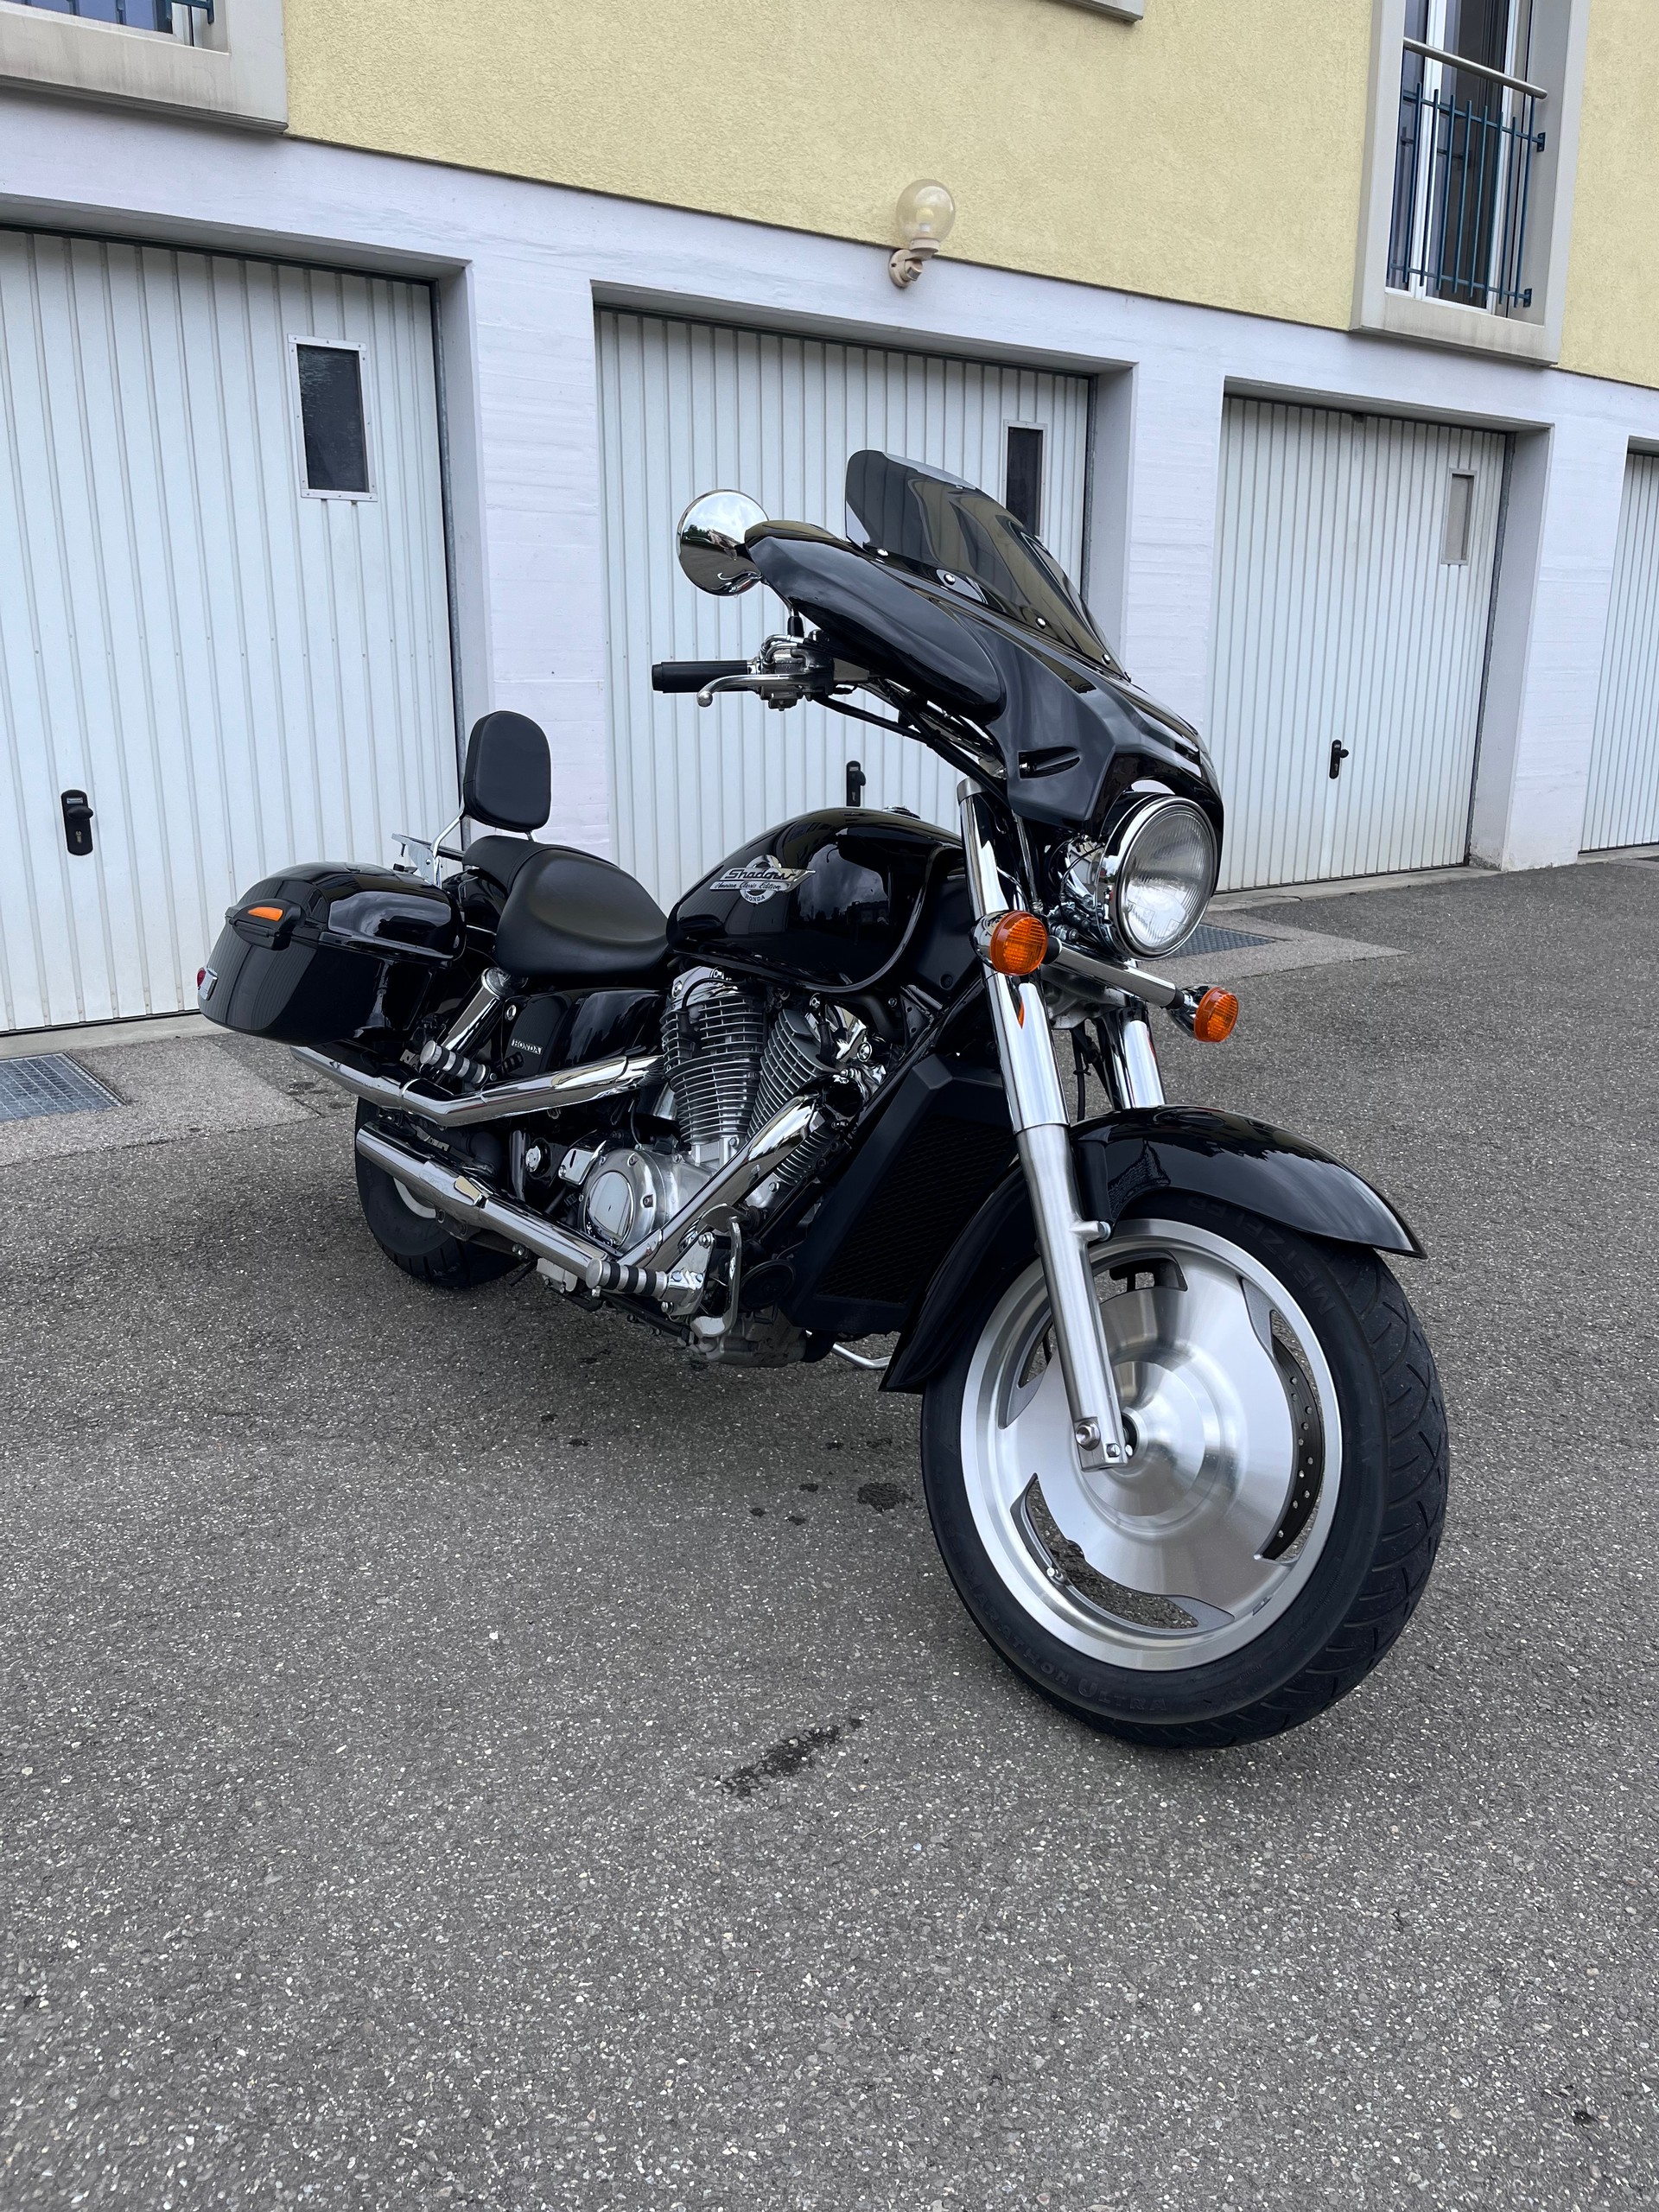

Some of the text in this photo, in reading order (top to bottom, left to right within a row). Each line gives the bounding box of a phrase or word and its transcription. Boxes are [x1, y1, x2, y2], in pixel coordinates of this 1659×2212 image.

[724, 868, 796, 880] Shadow
[745, 893, 766, 902] HONDA
[512, 1039, 543, 1054] HONDA
